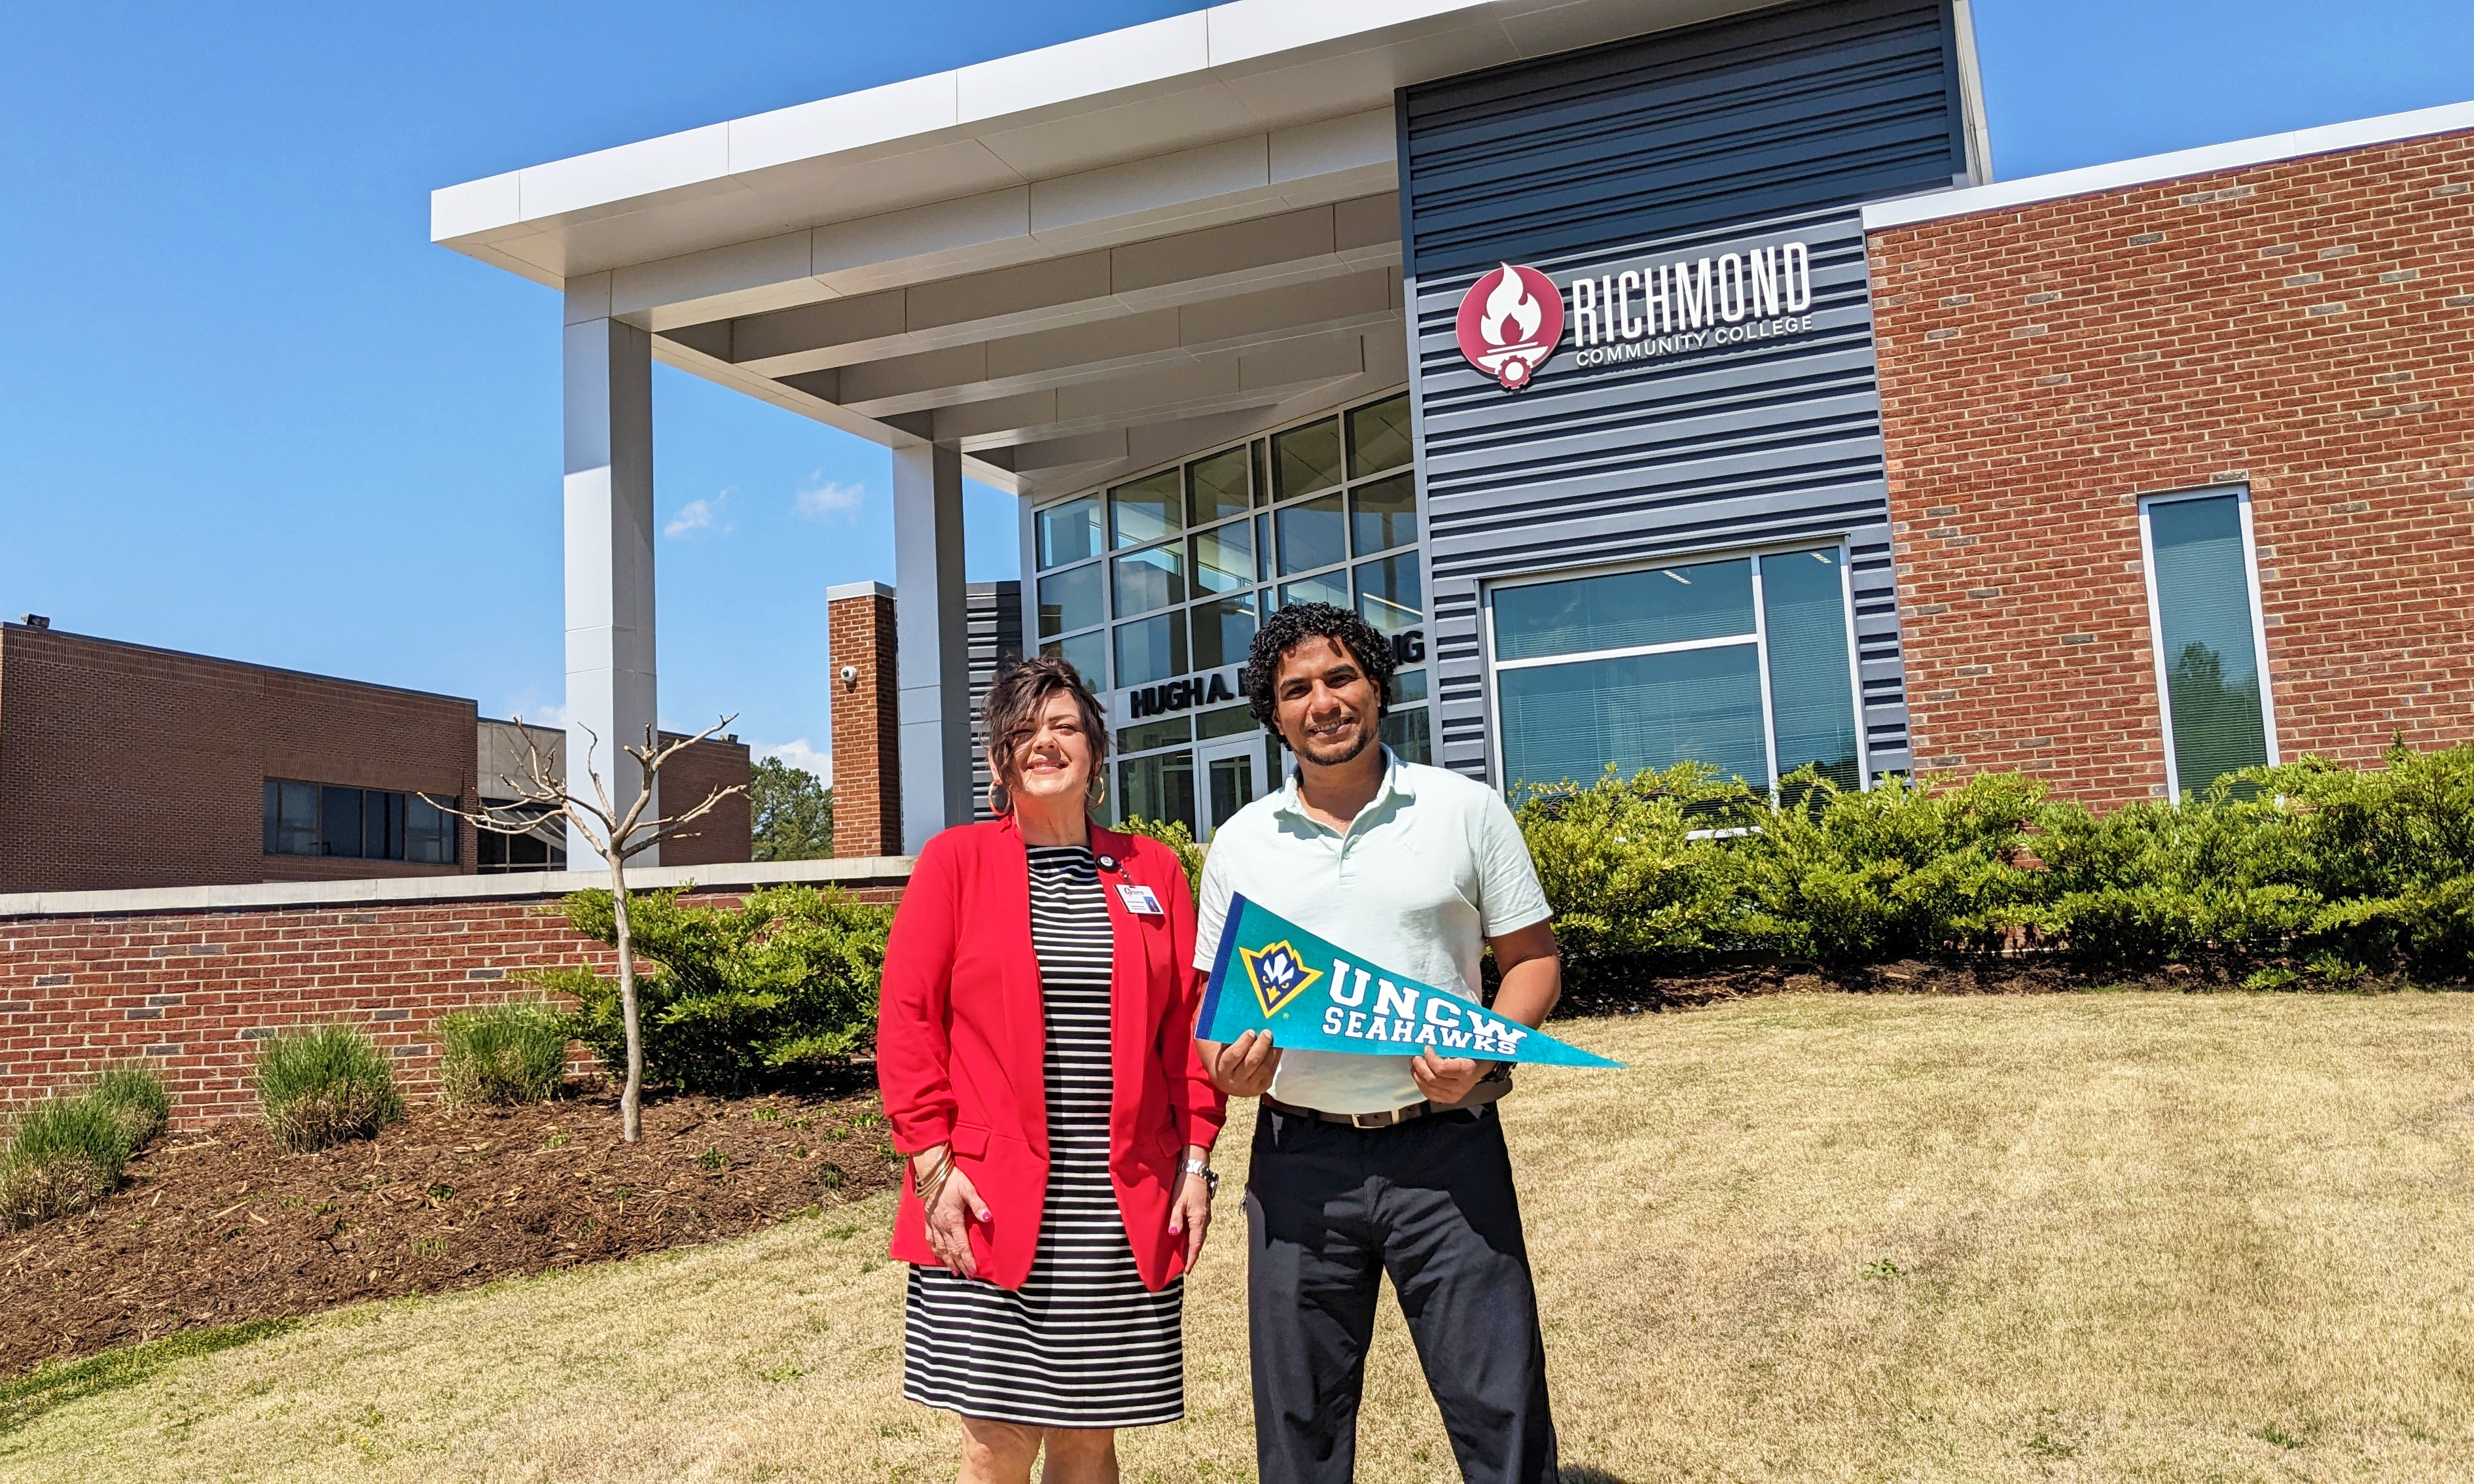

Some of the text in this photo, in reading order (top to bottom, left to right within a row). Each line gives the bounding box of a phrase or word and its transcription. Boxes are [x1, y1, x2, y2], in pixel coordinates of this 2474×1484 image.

[1572, 241, 1812, 347] RICHMOND
[1576, 315, 1813, 367] COMMUNITY COLLEGE
[1130, 677, 1204, 719] HUGH
[1206, 673, 1234, 704] A.
[1329, 957, 1528, 1044] UNCW
[1323, 1006, 1516, 1055] SEAHAWKS
